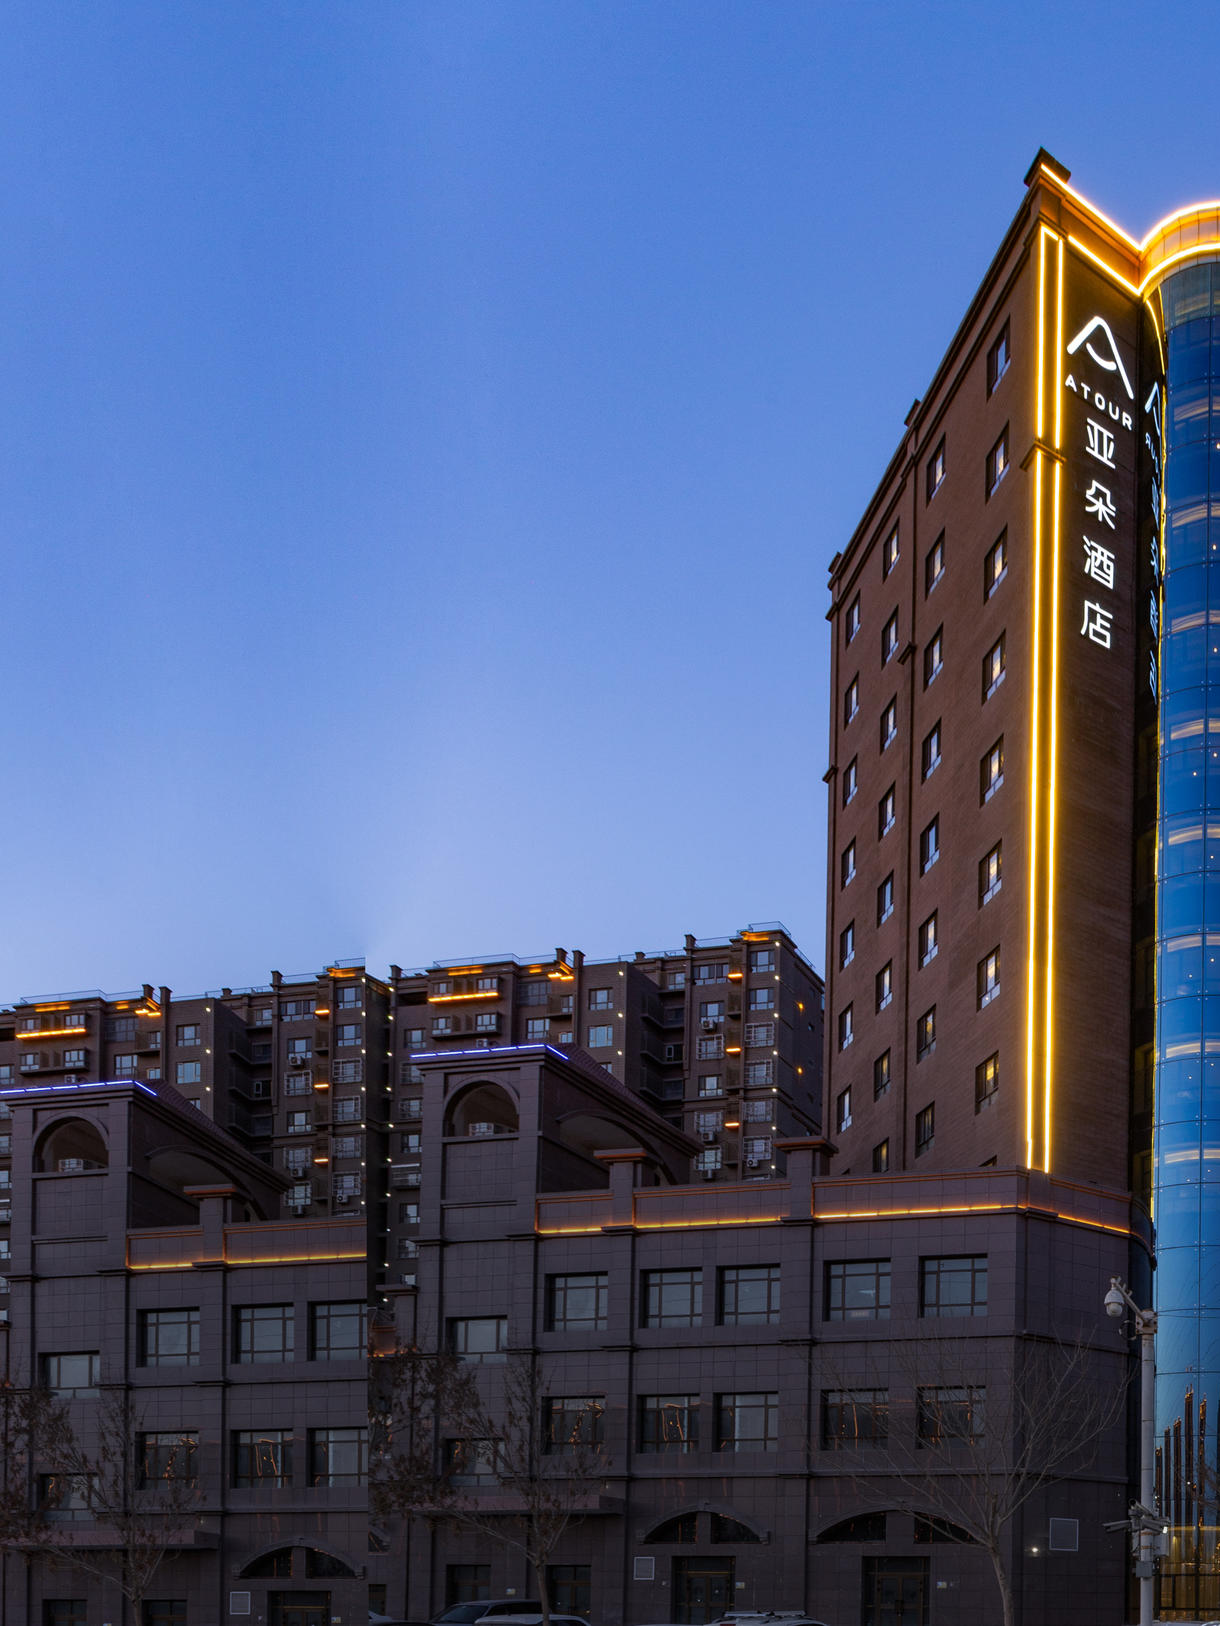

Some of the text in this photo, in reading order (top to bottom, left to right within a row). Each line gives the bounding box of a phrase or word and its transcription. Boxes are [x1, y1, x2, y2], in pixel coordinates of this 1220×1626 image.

[1065, 374, 1132, 430] ATOUR
[1080, 417, 1116, 648] 亚朵酒店
